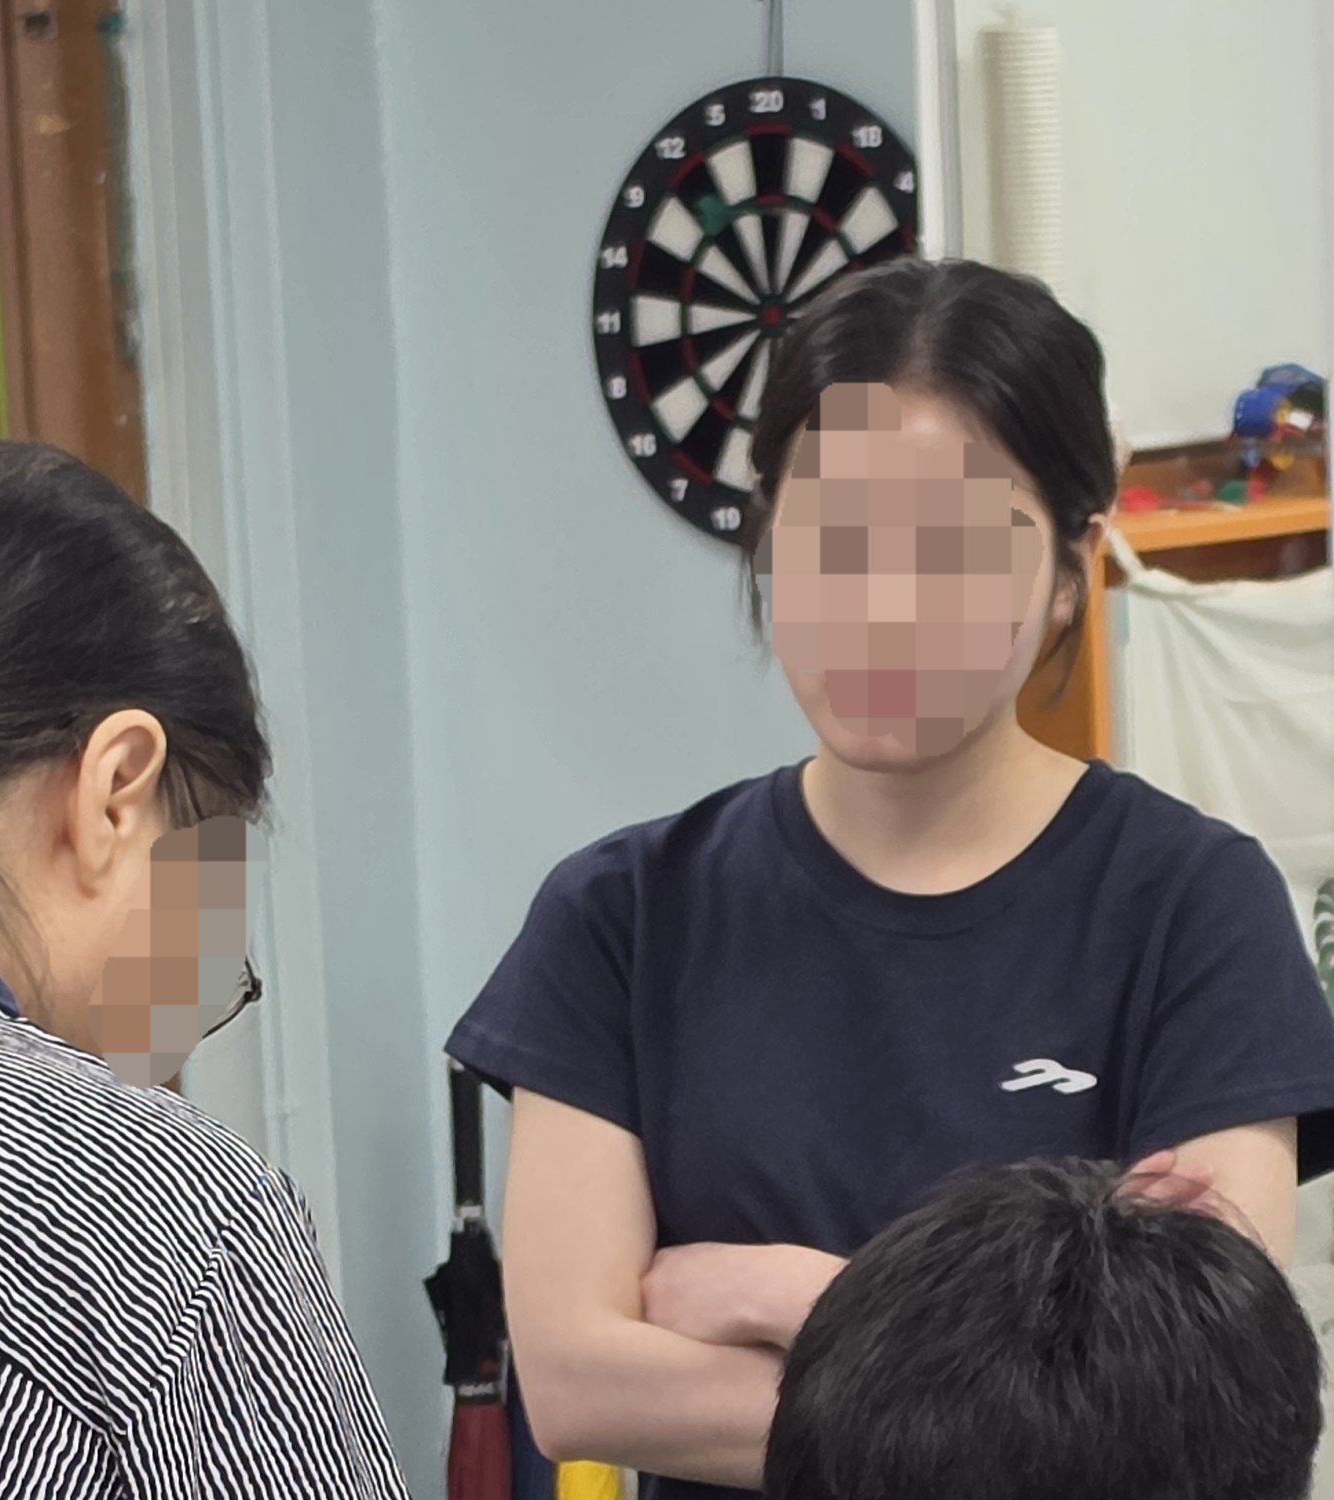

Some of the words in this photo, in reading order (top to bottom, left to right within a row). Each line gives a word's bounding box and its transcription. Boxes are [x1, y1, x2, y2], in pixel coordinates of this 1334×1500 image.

[750, 90, 784, 113] 20
[810, 98, 826, 120] 1
[706, 104, 726, 126] 5
[853, 125, 882, 148] 18
[656, 137, 686, 160] 12
[894, 171, 914, 193] 4
[624, 186, 645, 208] 9
[601, 246, 628, 269] 14
[597, 310, 621, 334] 11
[629, 432, 657, 457] 16
[670, 478, 689, 501] 7
[711, 506, 742, 531] 19
